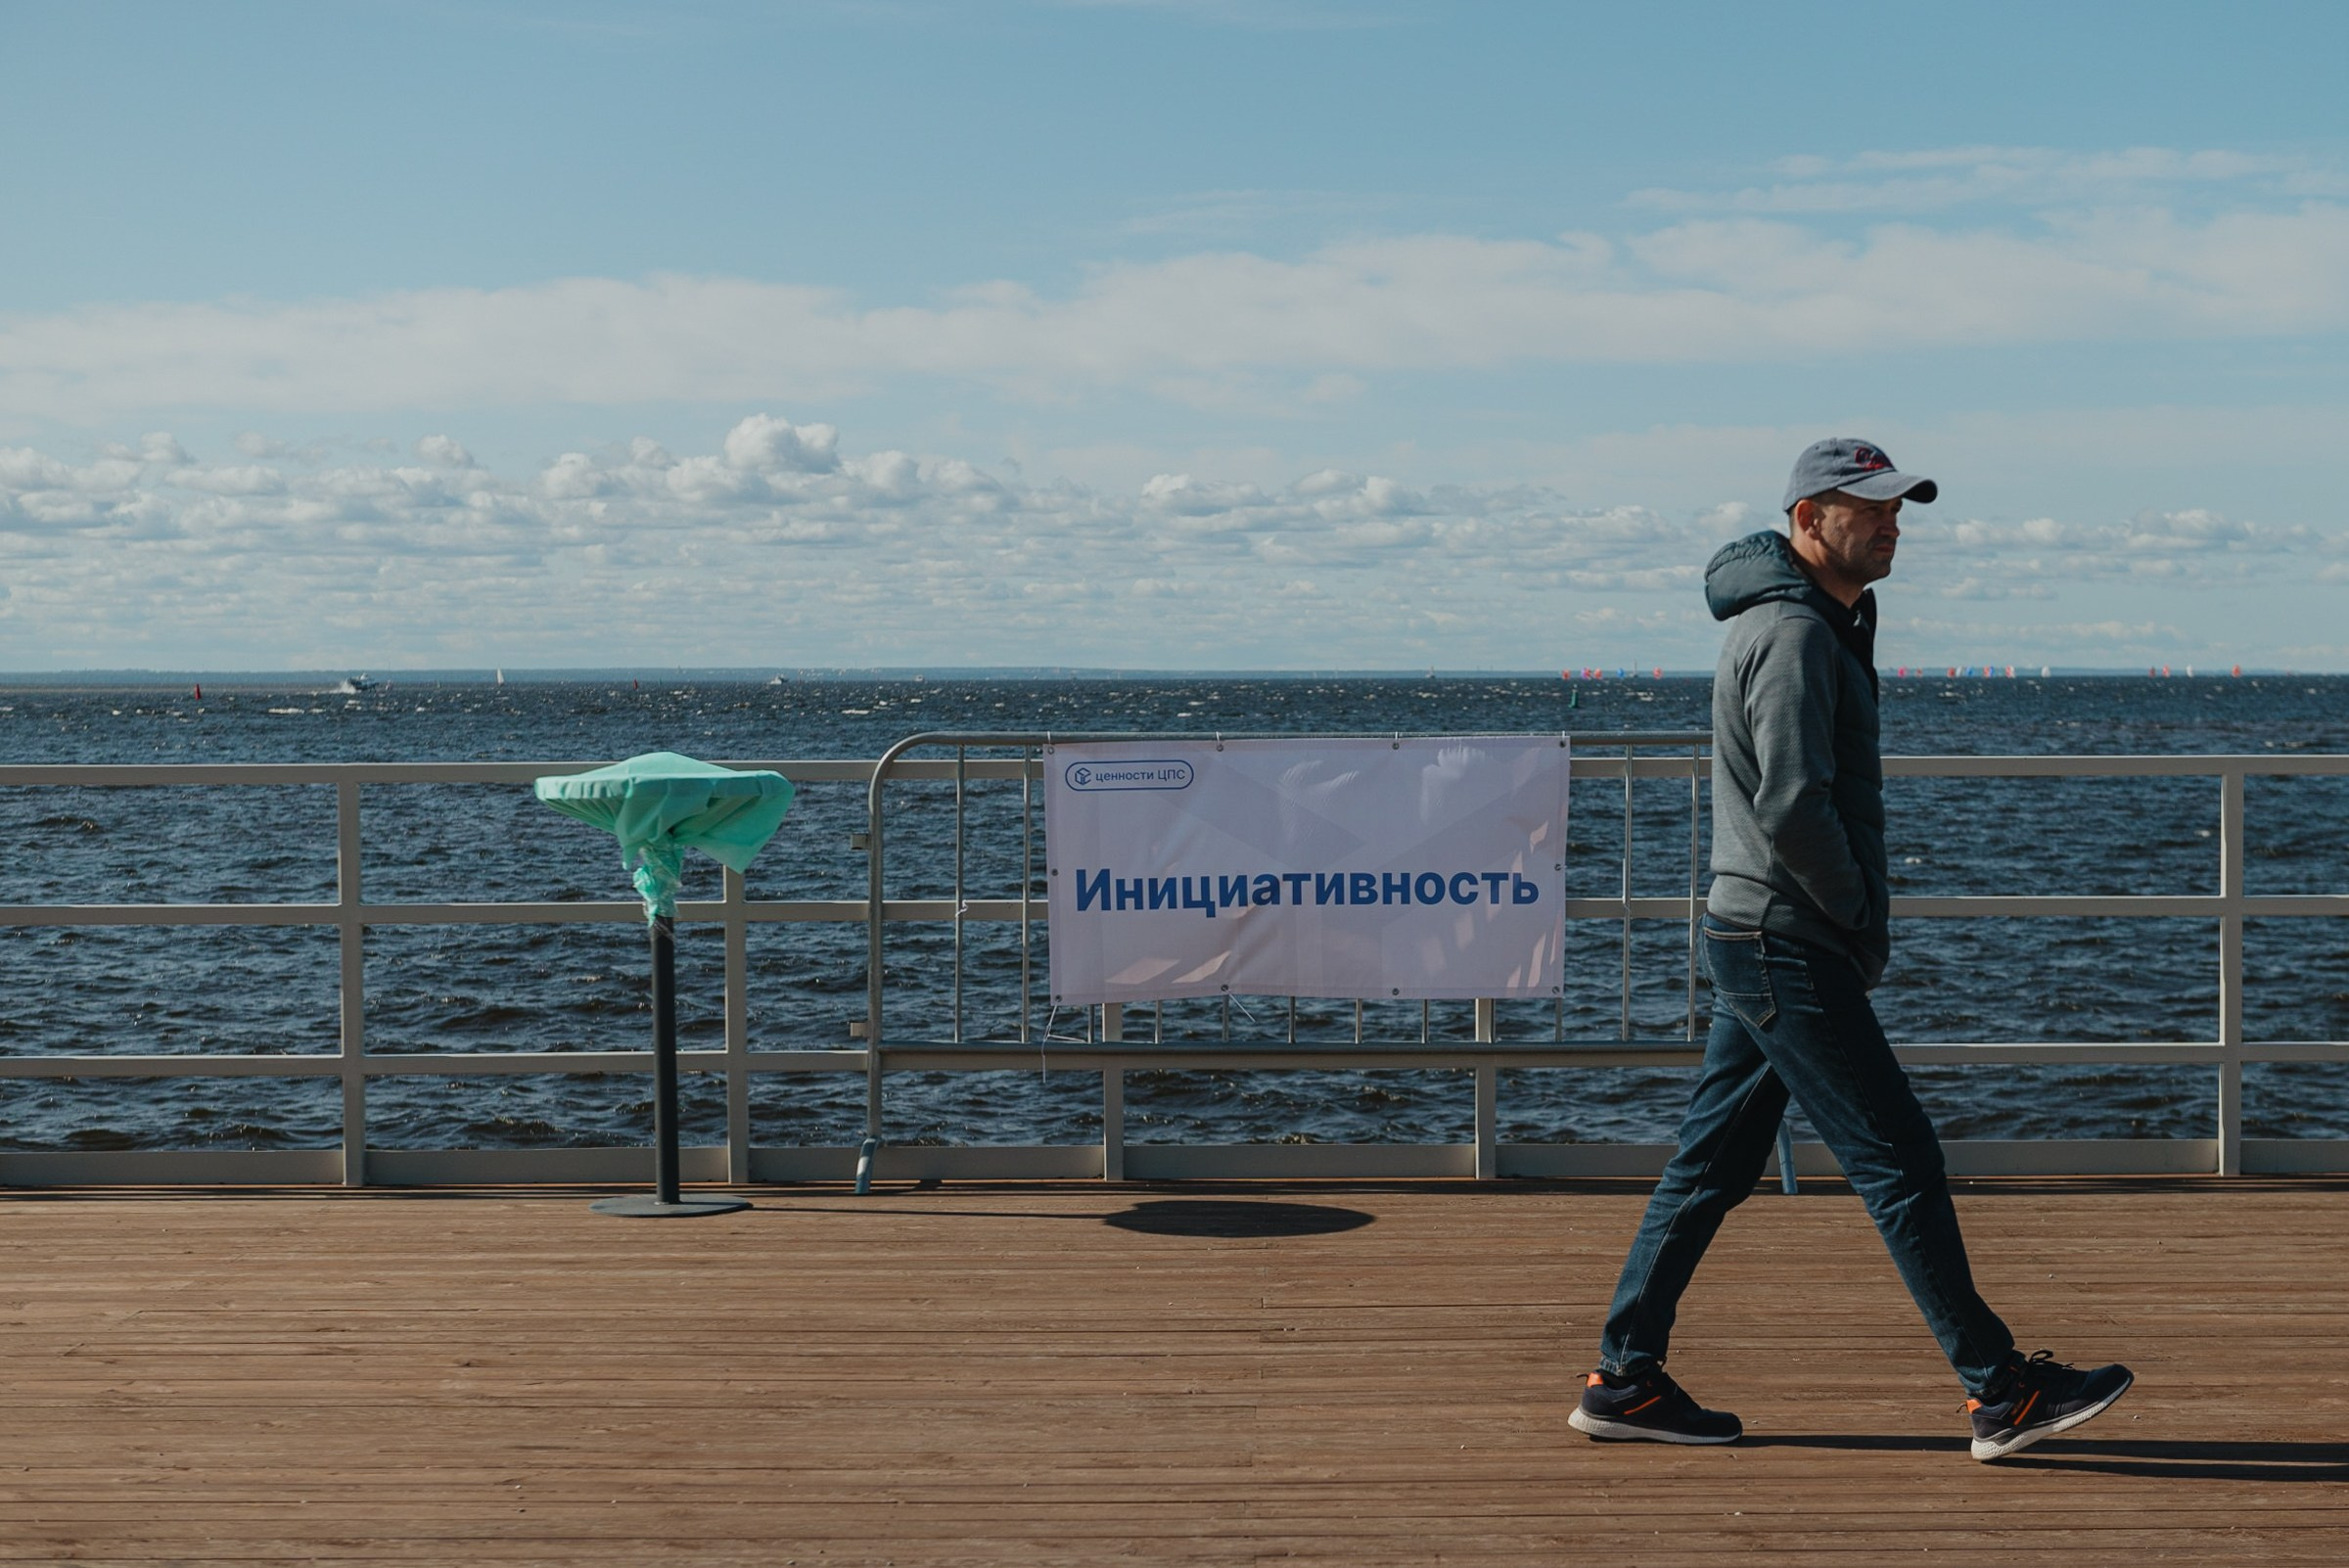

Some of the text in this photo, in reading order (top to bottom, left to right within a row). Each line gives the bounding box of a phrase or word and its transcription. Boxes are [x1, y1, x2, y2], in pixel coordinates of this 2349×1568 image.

[1095, 769, 1186, 783] ценности ЦПС
[1076, 868, 1540, 918] Инициативность
